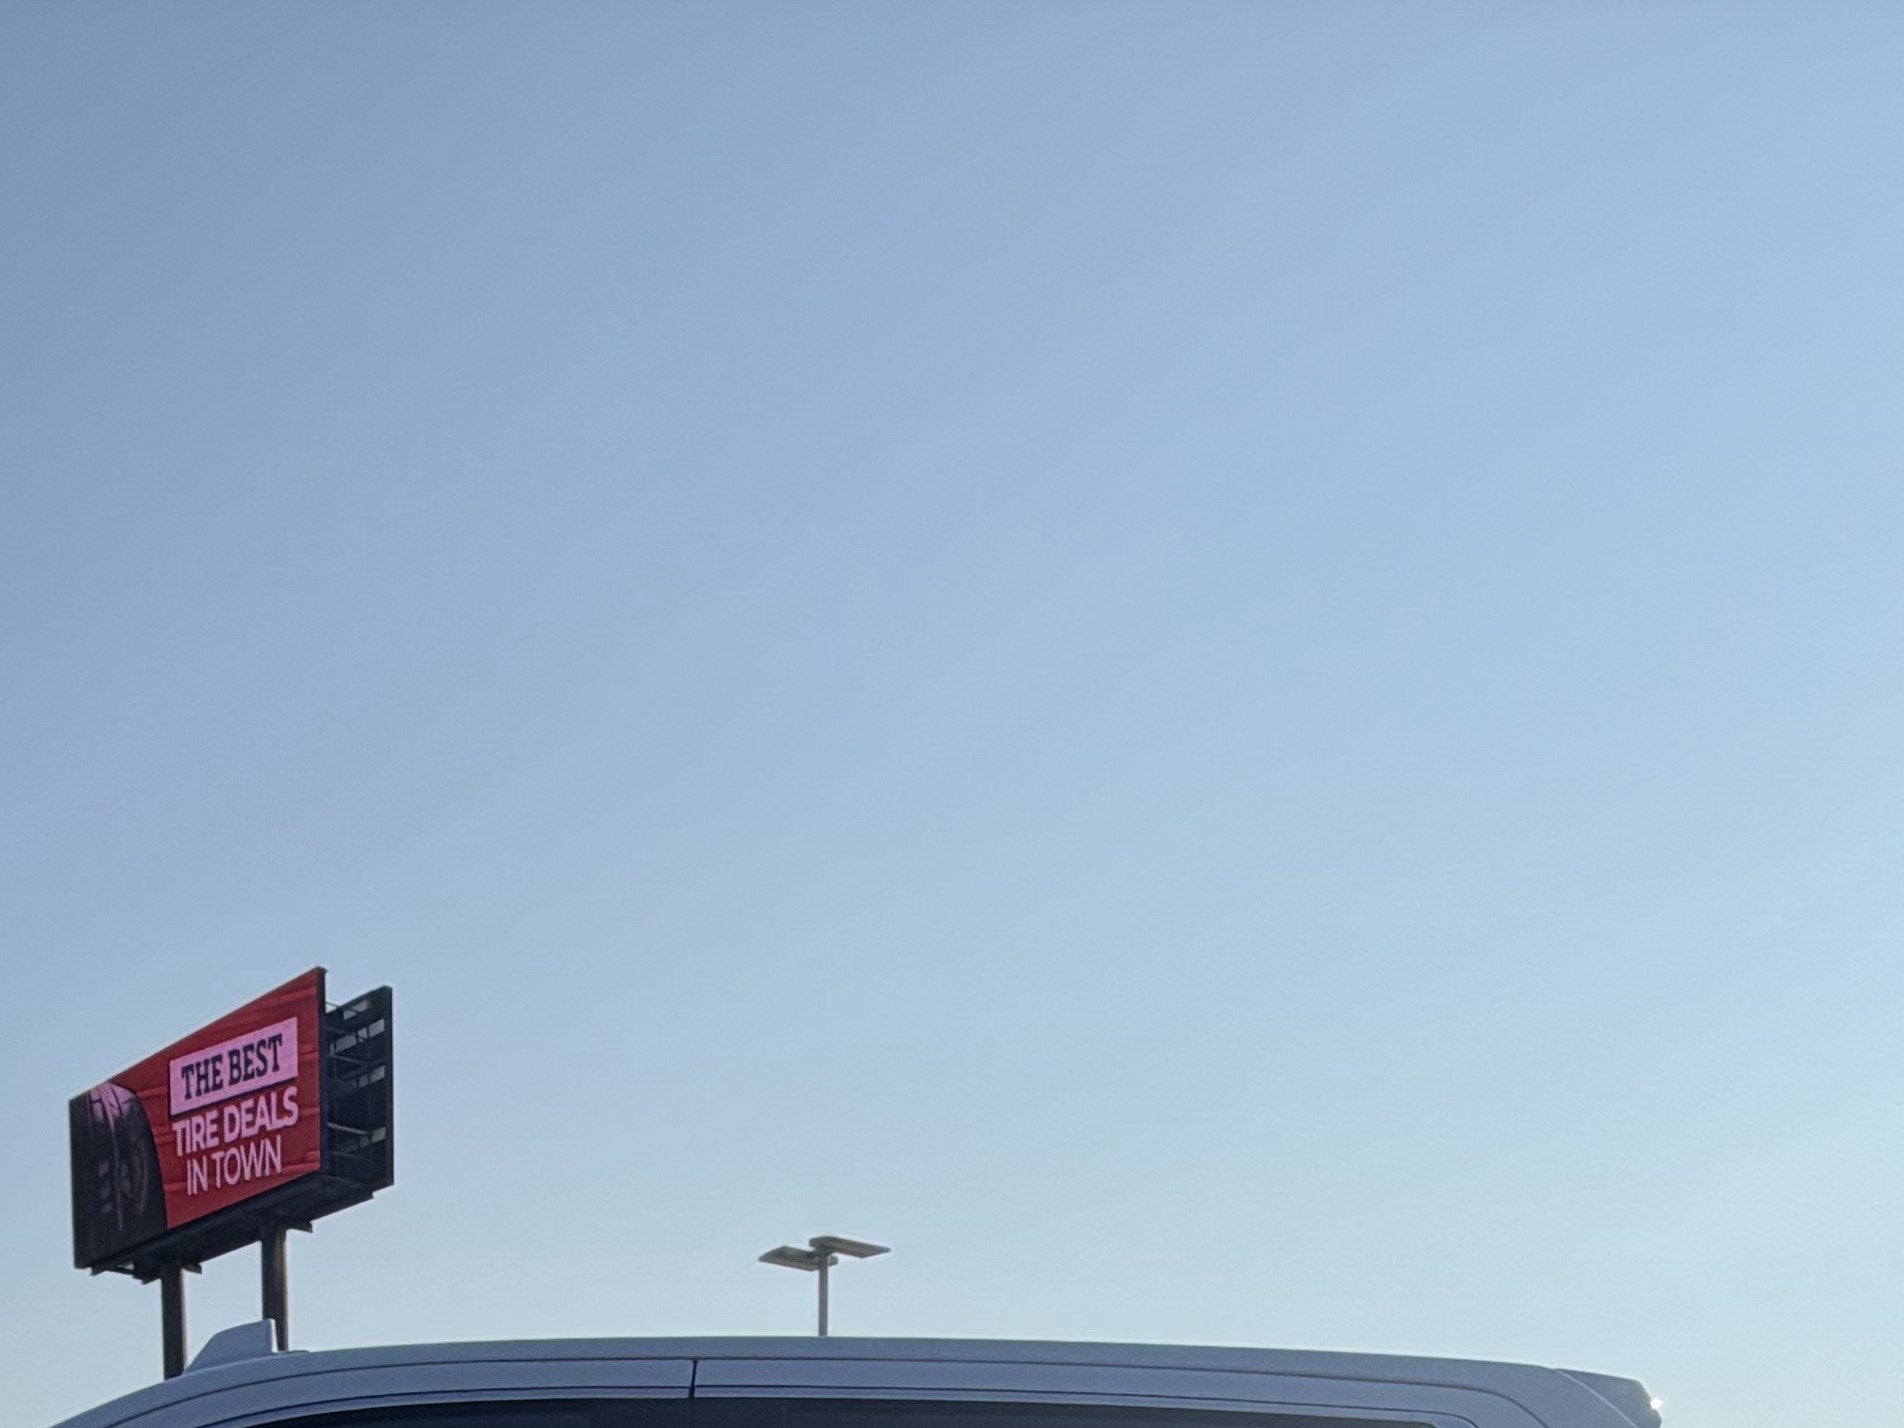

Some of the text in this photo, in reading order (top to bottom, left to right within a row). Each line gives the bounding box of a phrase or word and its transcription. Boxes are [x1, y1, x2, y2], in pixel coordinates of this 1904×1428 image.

[181, 1033, 283, 1100] THE BEST
[172, 1086, 299, 1157] TIRE DEALS
[186, 1134, 282, 1195] IN TOWN
